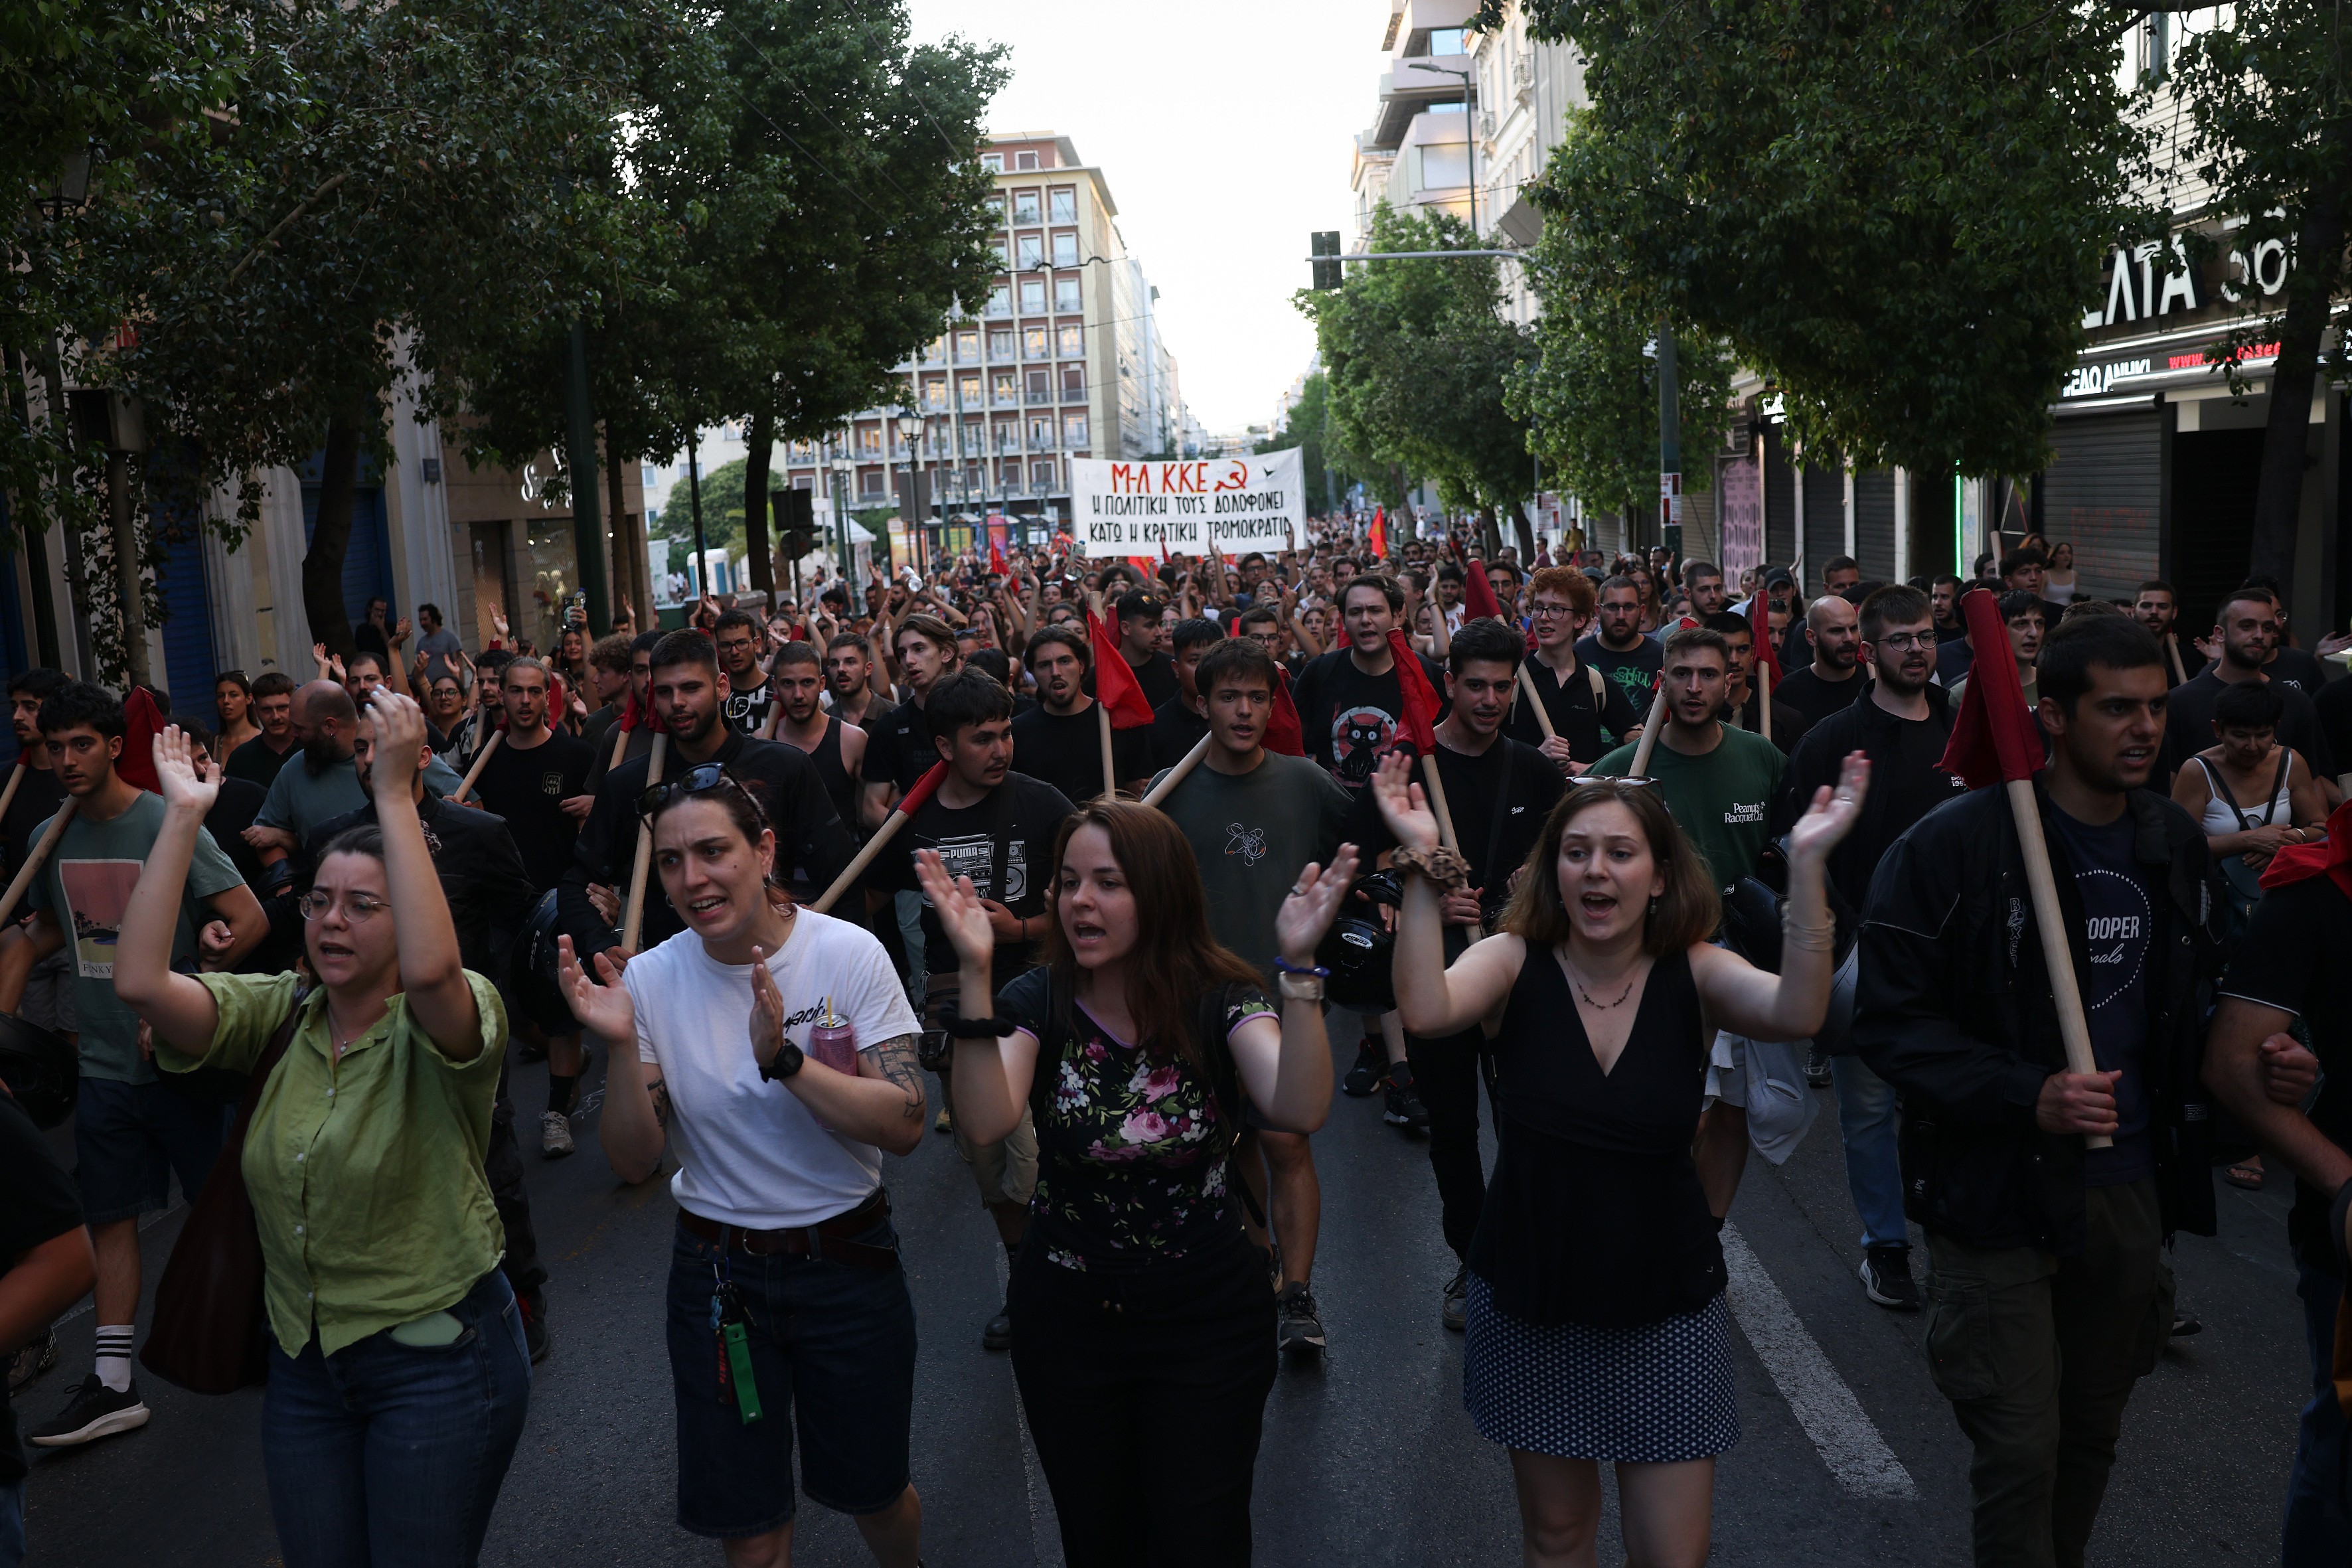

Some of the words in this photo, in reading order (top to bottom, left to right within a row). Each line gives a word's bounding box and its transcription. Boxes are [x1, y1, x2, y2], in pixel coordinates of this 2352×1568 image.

[1162, 463, 1209, 494] ΚΚΕ
[1093, 495, 1101, 515] Η
[1105, 495, 1167, 516] ΠΟΛΙΤΙΚΗ
[1175, 496, 1206, 515] ΤΟΥΣ
[1215, 491, 1283, 514] ΔΟΛΟΦΟΝΕΙ
[1090, 522, 1122, 542] ΚΑΤΩ
[1130, 523, 1138, 542] Η
[1144, 522, 1197, 542] ΚΡΑΤΙΚΗ
[1207, 516, 1291, 540] ΤΡΟΜΟΚΡΑΤΙΑ
[1725, 811, 1754, 823] Racquet
[1733, 802, 1760, 814] Peanuts
[950, 846, 978, 859] PUMA
[2086, 915, 2140, 940] OOPER
